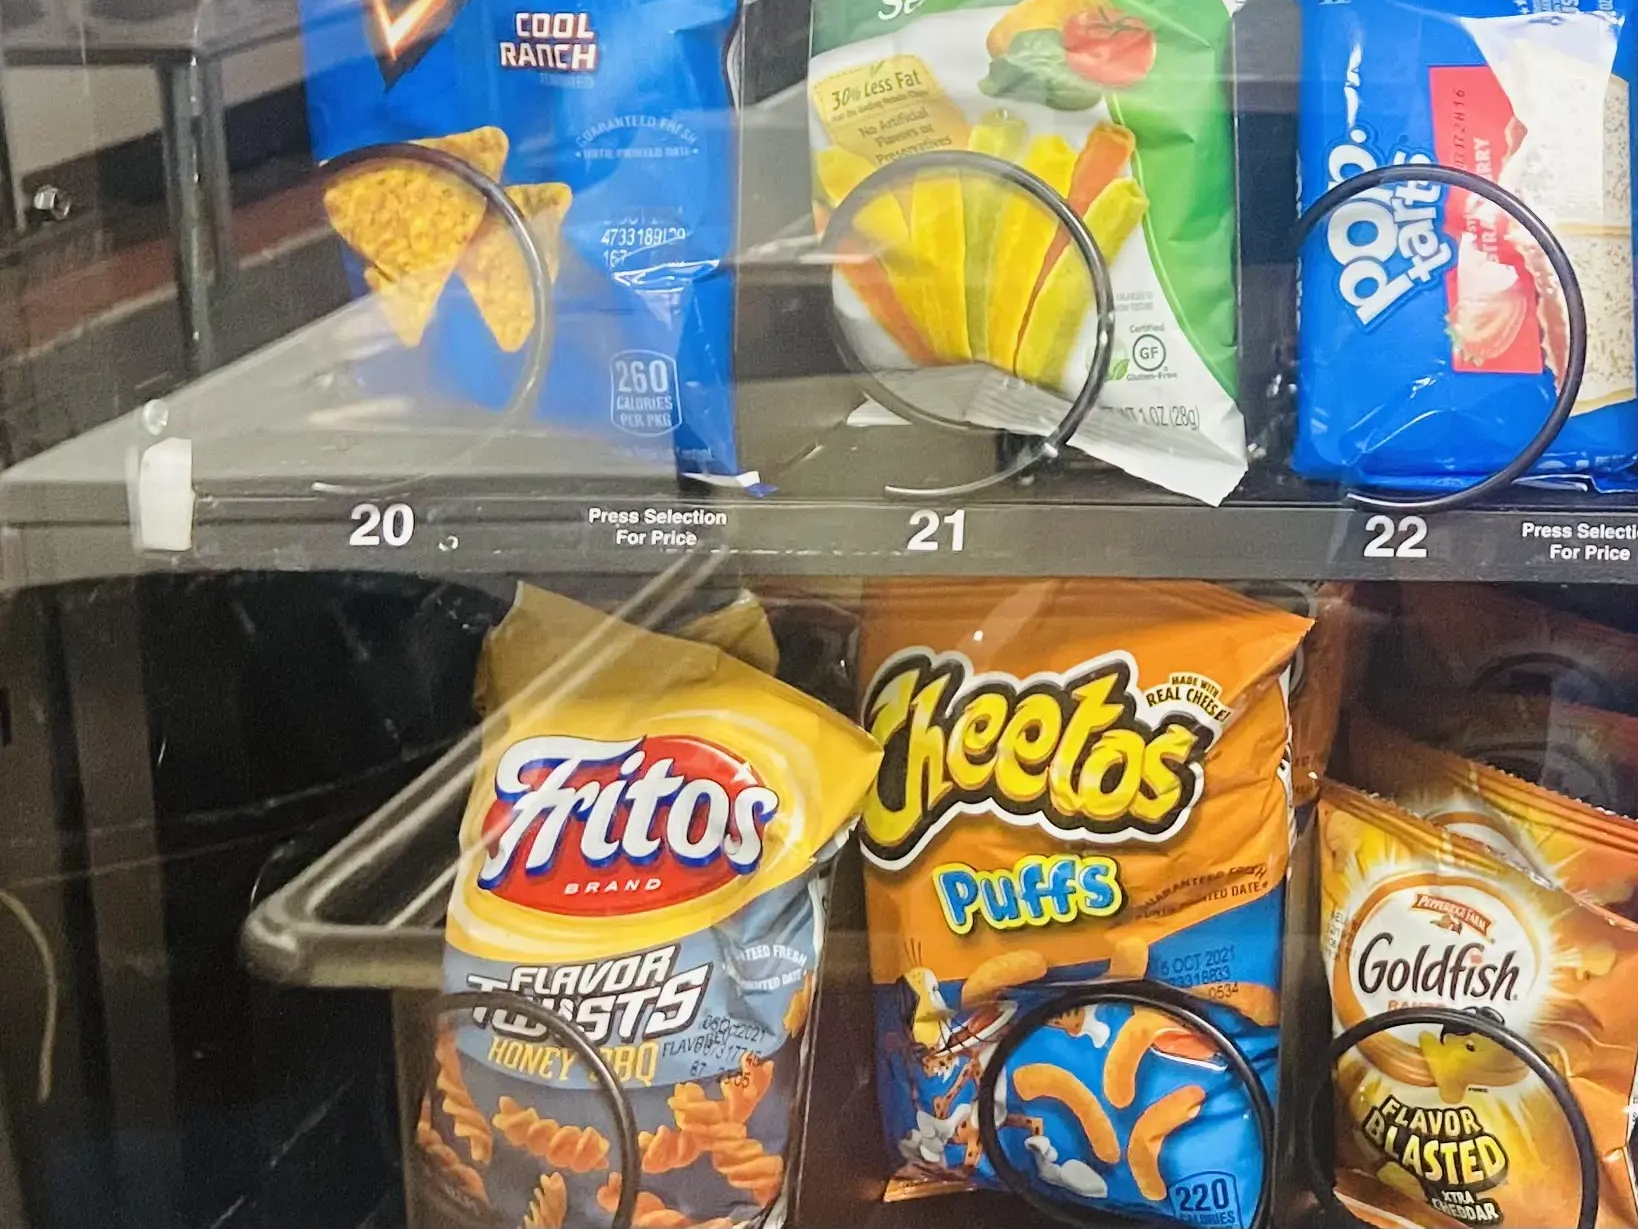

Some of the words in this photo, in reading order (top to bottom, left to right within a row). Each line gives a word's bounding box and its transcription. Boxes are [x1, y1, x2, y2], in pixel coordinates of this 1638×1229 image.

[515, 12, 595, 39] COOL
[500, 42, 596, 70] RANCH
[863, 77, 894, 98] Less
[894, 69, 923, 89] Fat
[1139, 346, 1160, 361] GF
[616, 360, 668, 393] 260
[615, 394, 674, 413] CALORIES
[619, 412, 645, 428] PER
[1169, 404, 1201, 432] (28g)
[349, 504, 415, 547] 20
[587, 507, 641, 527] Press
[644, 508, 728, 527] Selection
[906, 509, 967, 552] 21
[615, 528, 646, 547] For
[651, 528, 698, 548] Price
[1363, 516, 1428, 558] 22
[1521, 523, 1572, 540] Press
[1549, 545, 1579, 561] For
[1584, 545, 1631, 562] Price
[1146, 685, 1182, 708] REAL
[1170, 674, 1198, 688] MADE
[1200, 679, 1220, 698] WITH
[862, 662, 1201, 848] Cheetos
[477, 734, 780, 891] Fritos
[563, 878, 662, 896] BRAND
[937, 858, 1111, 928] Puffs
[510, 945, 678, 992] FLAVOR
[772, 944, 808, 967] FRESH
[1205, 946, 1236, 967] 2021
[1357, 932, 1521, 1002] Goldfish
[488, 1036, 576, 1081] HONEY
[1381, 1095, 1482, 1136] FLAVOR
[1364, 1106, 1507, 1185] BLASTED
[1174, 1184, 1229, 1212] 220
[1431, 1196, 1500, 1222] CHEDDAR
[1441, 1190, 1474, 1205] XTRA
